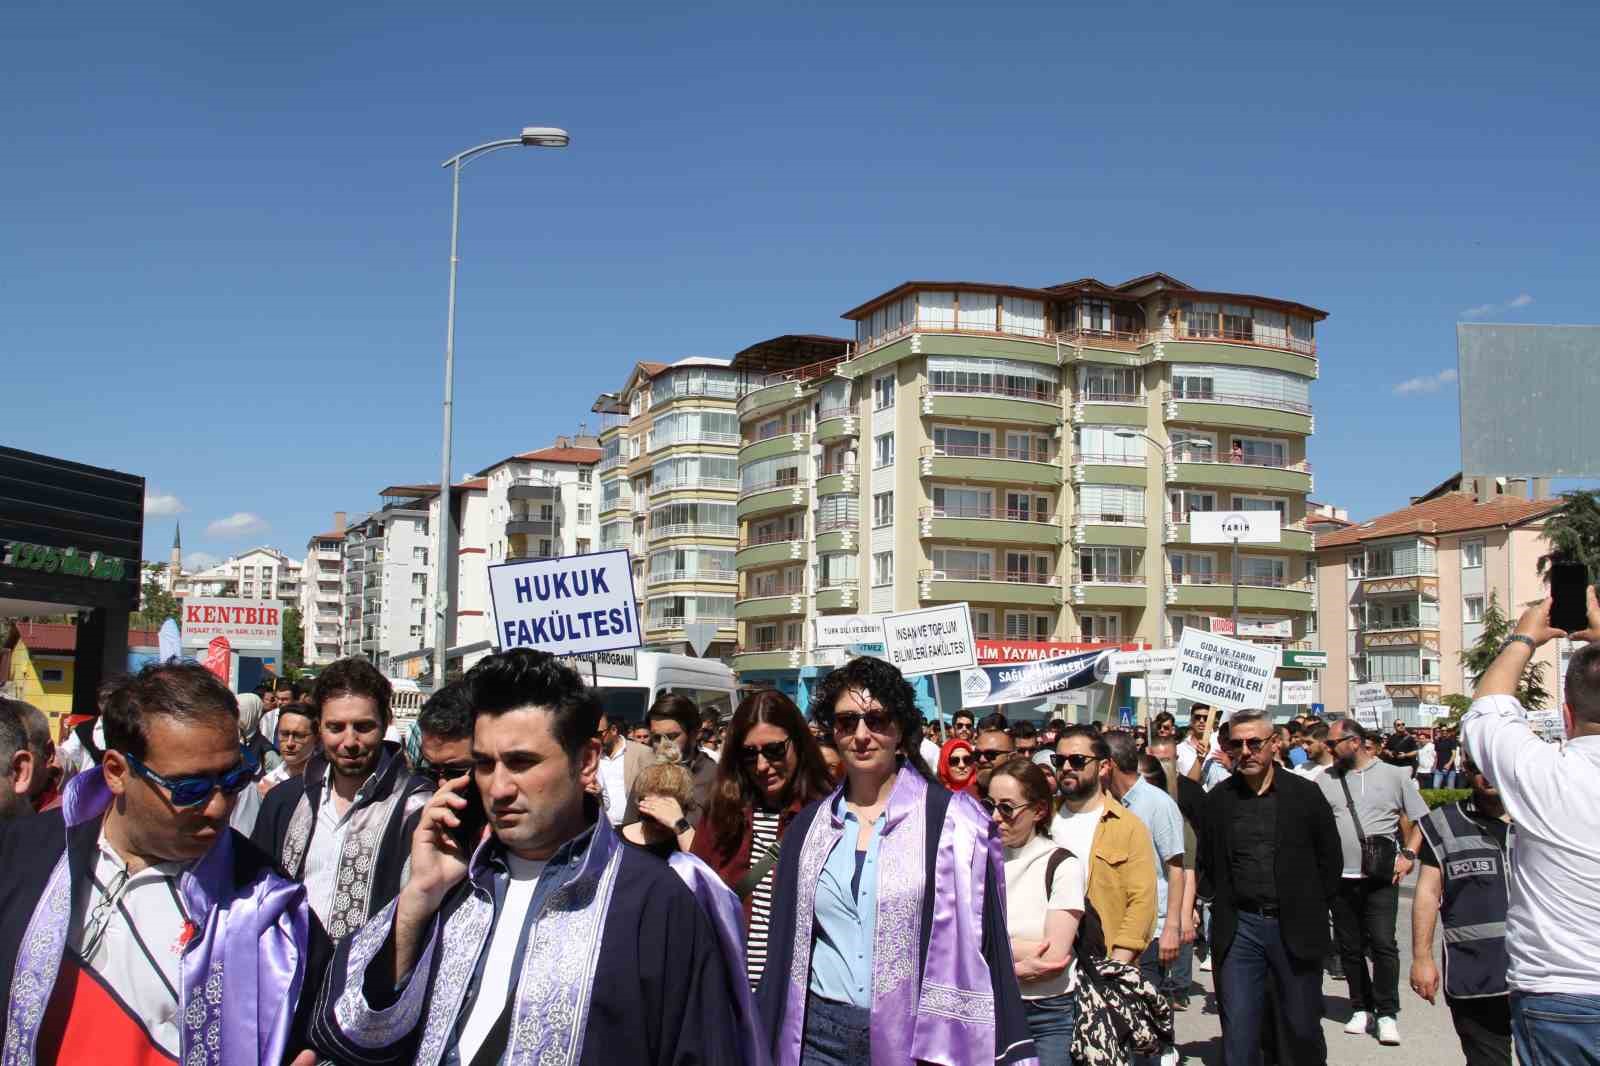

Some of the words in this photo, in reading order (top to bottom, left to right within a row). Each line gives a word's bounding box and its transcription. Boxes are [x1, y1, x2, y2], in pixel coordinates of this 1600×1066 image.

[514, 567, 610, 603] HUKUK
[186, 602, 279, 625] KENTBİR
[503, 600, 632, 647] FAKÜLTESİ
[861, 624, 880, 633] EDEBİY
[895, 626, 917, 641] İNSAN
[917, 624, 928, 638] VE
[928, 620, 957, 637] TOPLUM
[597, 652, 633, 666] PROGRAMI
[894, 645, 928, 663] BİLİMLERİ
[1001, 646, 1046, 660] YAYMA
[1183, 648, 1213, 663] MESLEK
[1200, 642, 1218, 652] GIDA
[1220, 647, 1230, 656] VE
[1232, 650, 1256, 663] TARIM
[1182, 662, 1211, 678] TARLA
[1214, 670, 1264, 693] BİTKİLERİ
[1191, 680, 1245, 703] PROGRAMI
